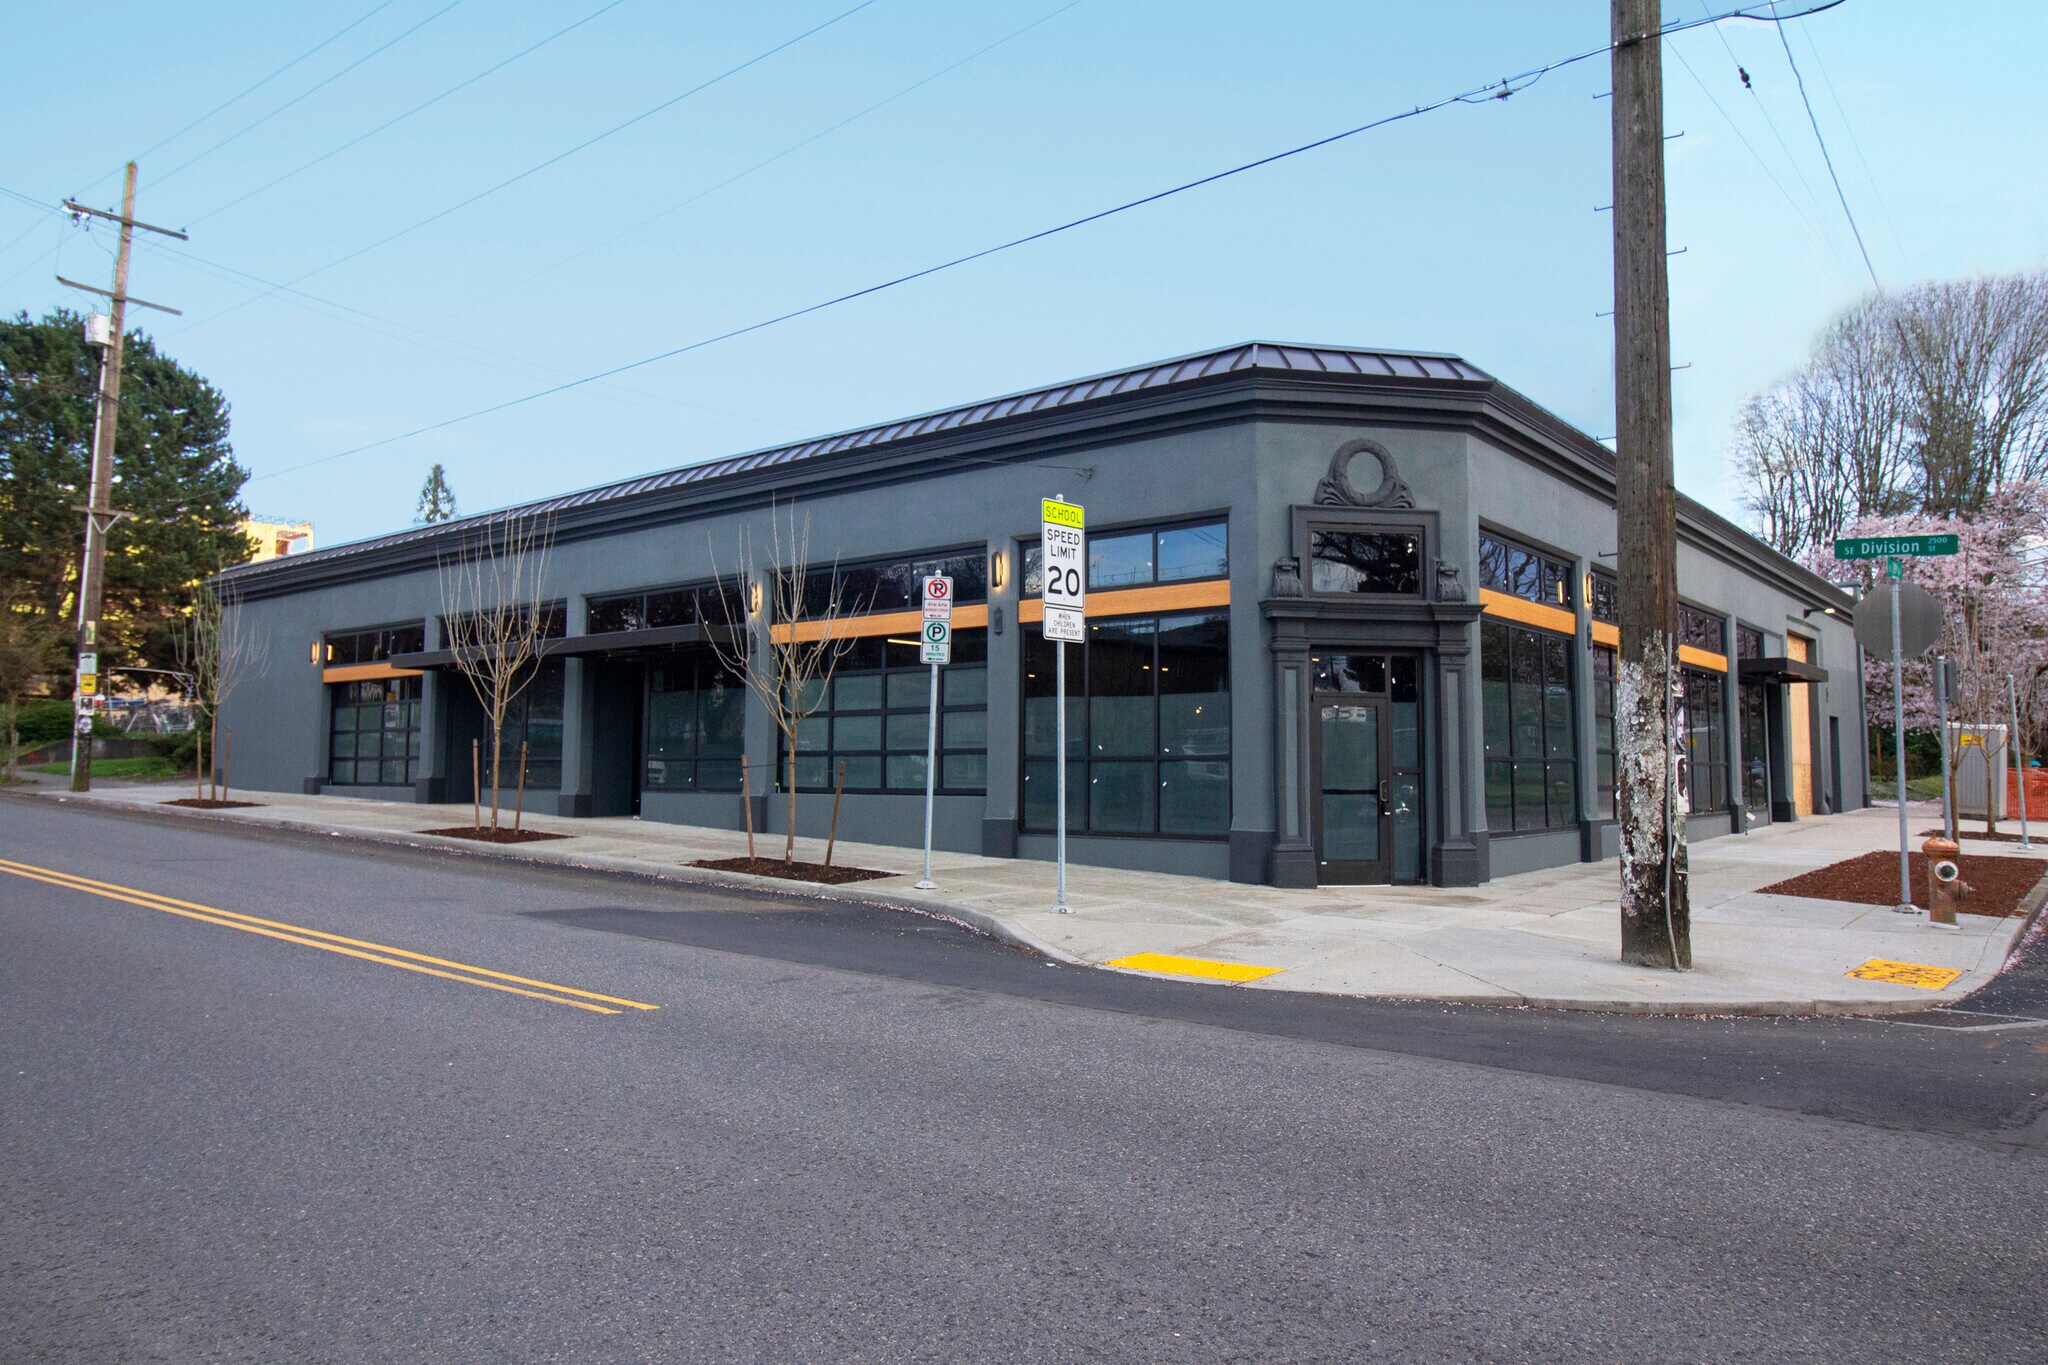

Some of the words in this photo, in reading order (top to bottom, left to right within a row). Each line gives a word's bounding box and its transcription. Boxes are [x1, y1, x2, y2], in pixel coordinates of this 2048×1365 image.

[1046, 506, 1081, 524] SCHOOL
[1047, 529, 1080, 545] SPEED
[1050, 545, 1076, 560] LIMIT
[1844, 546, 1855, 555] SE
[1861, 540, 1920, 555] Division
[1048, 566, 1080, 596] 20
[1048, 627, 1058, 635] ARE
[1060, 628, 1080, 637] PRESENT
[1053, 620, 1076, 629] CHILDREN
